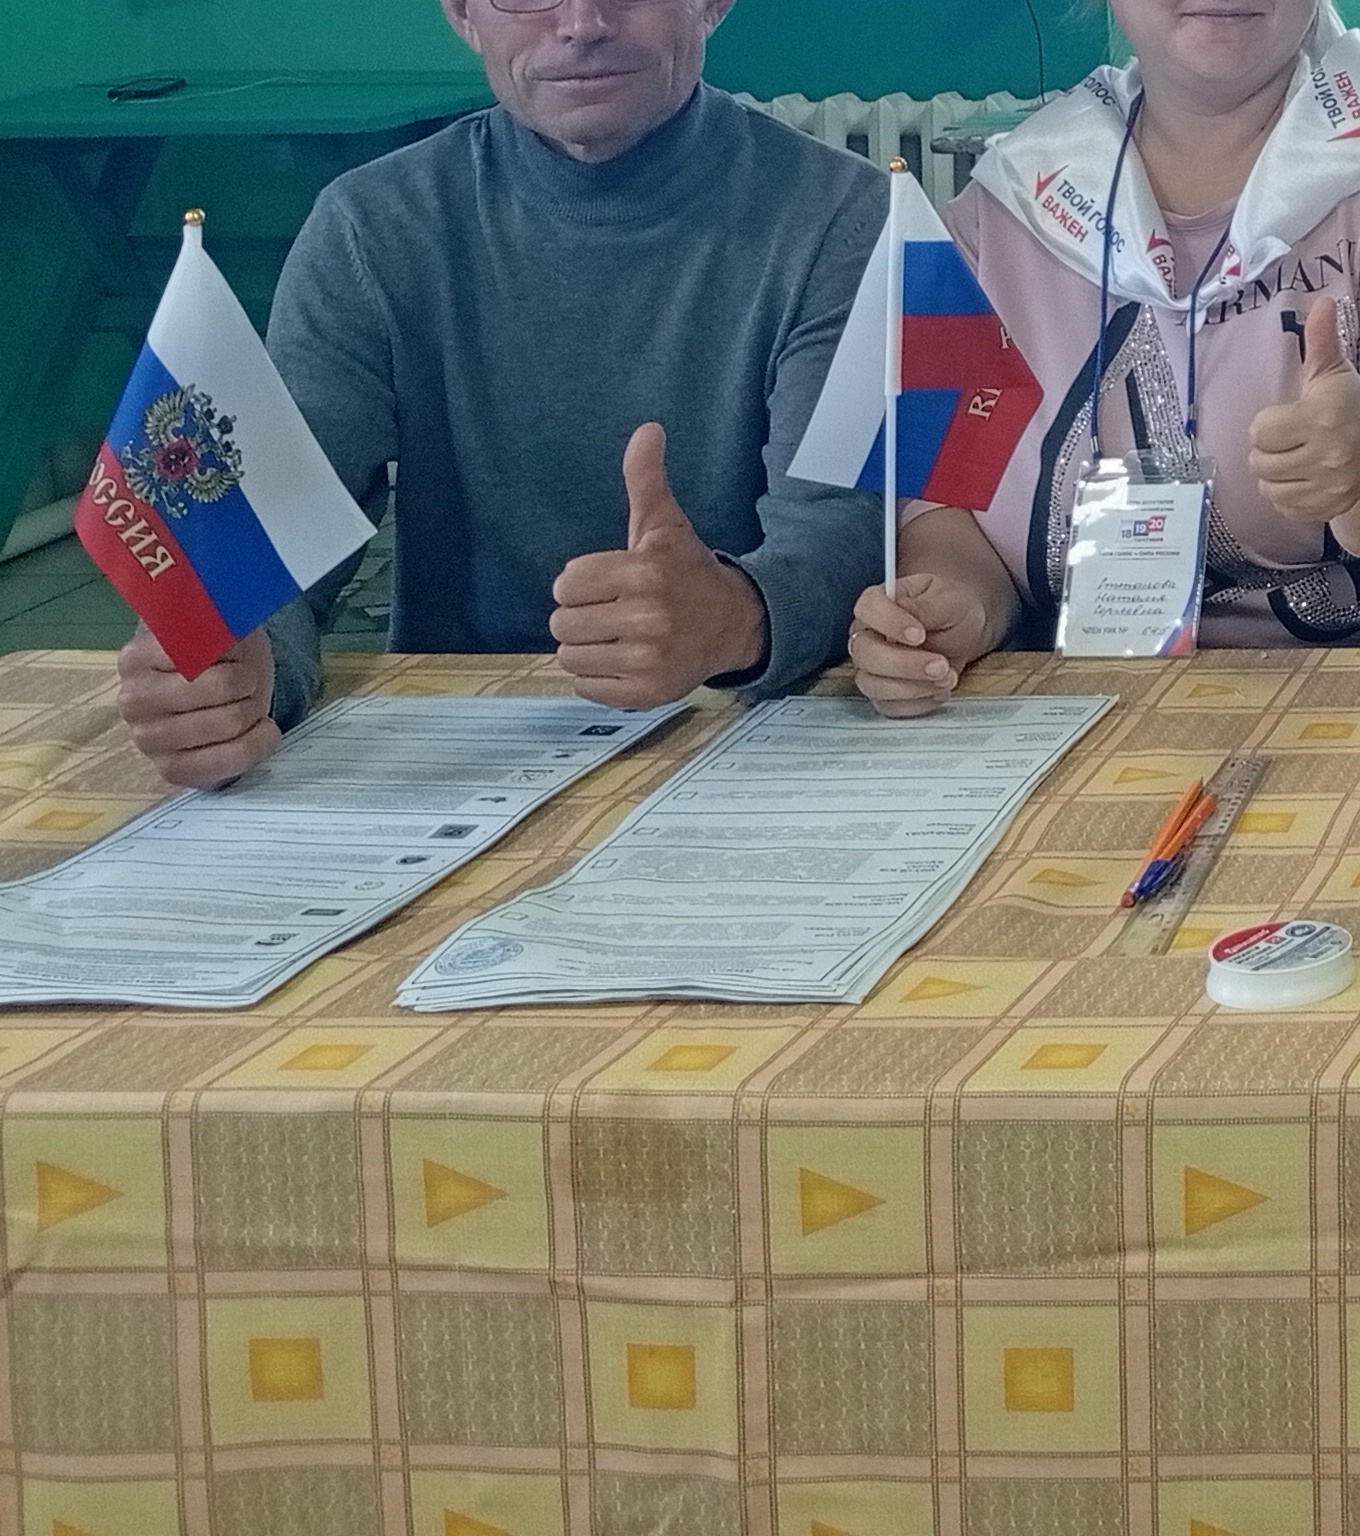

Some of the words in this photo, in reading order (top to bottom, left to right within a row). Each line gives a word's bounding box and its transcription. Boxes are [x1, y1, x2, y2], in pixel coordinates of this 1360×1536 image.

[1084, 76, 1116, 106] ОЛОС
[1314, 87, 1347, 129] ТВОЙ
[1057, 178, 1096, 217] ТВОЙ
[1042, 195, 1089, 243] ВАЖЕН
[89, 463, 177, 581] ОССИЯ
[1135, 524, 1147, 534] 19
[1148, 519, 1164, 529] 20
